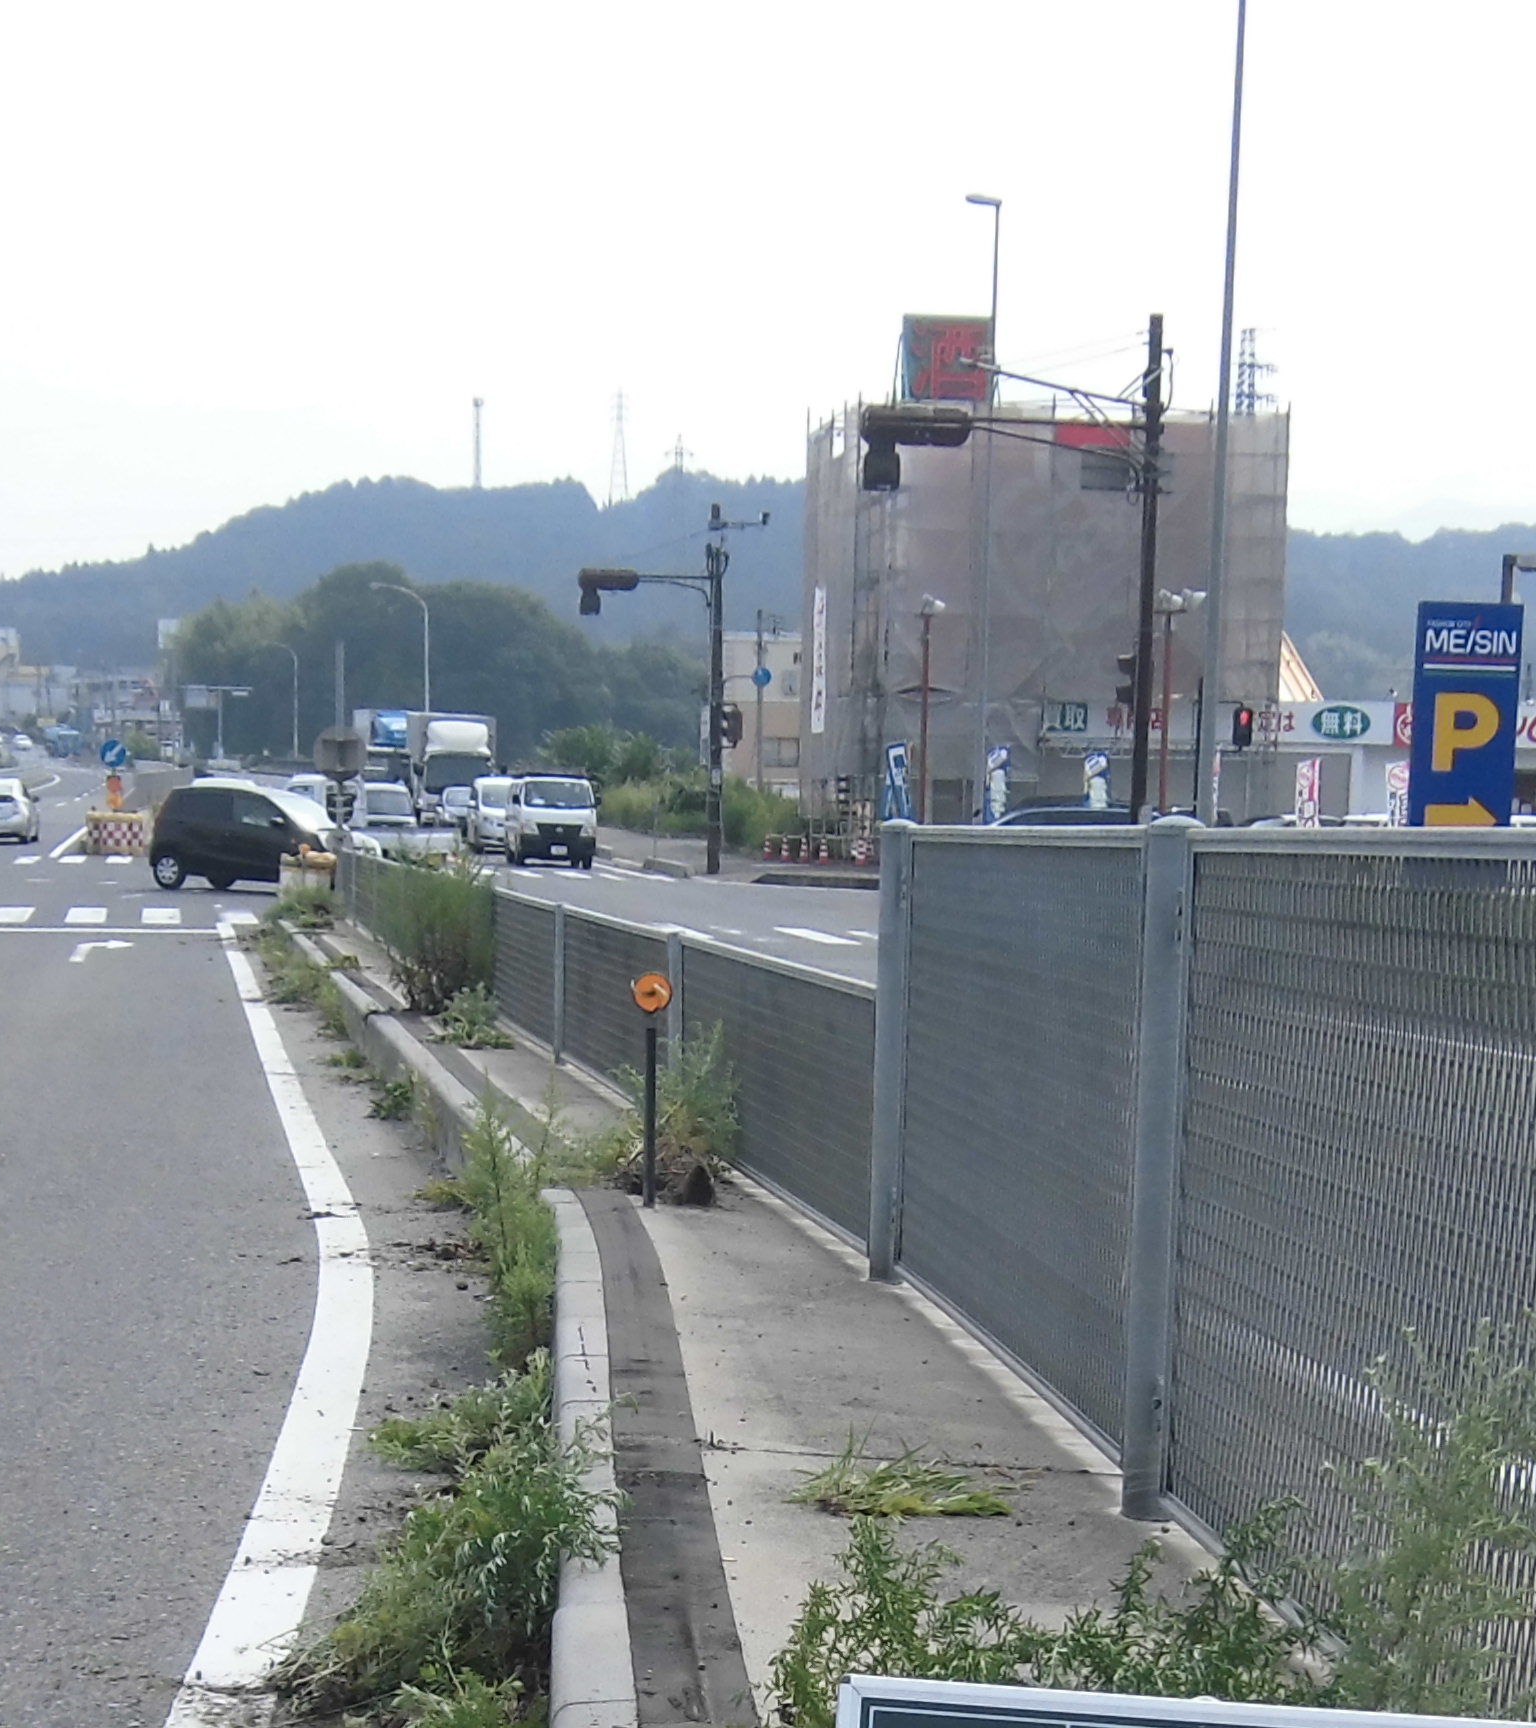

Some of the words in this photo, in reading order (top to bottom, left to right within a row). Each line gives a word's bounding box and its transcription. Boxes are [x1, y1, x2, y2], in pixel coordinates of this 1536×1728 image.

[911, 321, 988, 400] 酒
[1321, 711, 1363, 736] 無料
[1432, 692, 1500, 772] P
